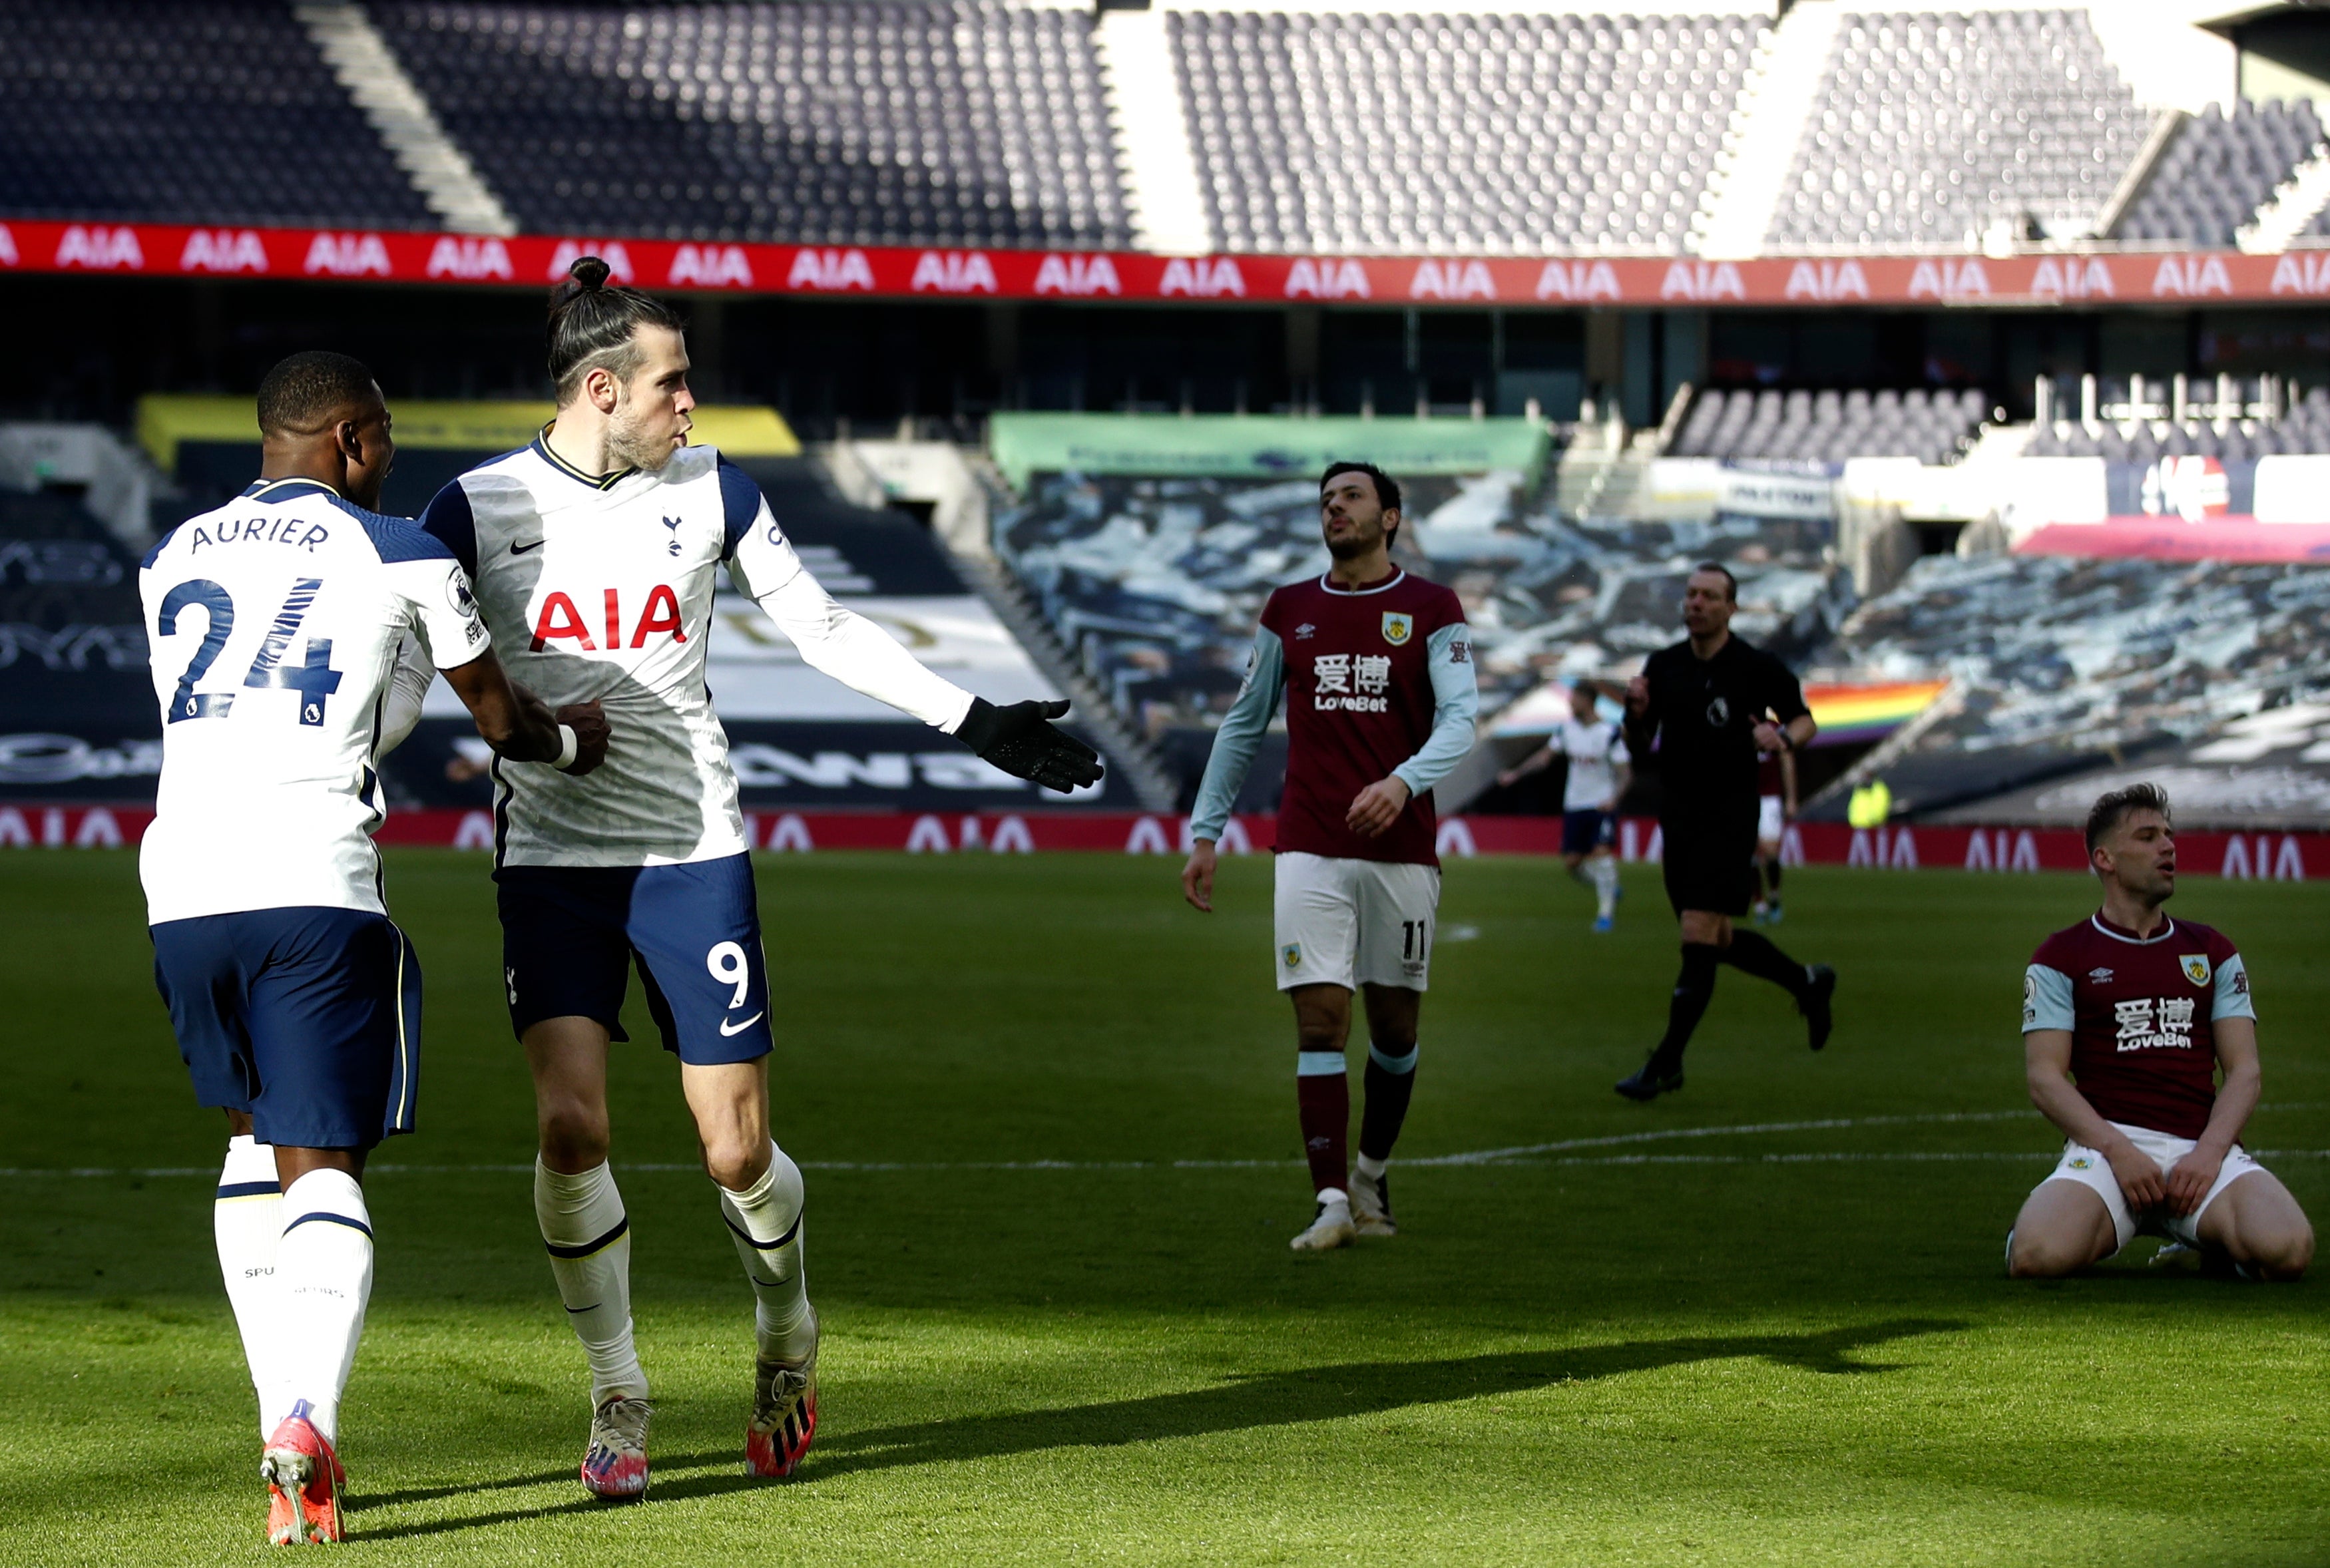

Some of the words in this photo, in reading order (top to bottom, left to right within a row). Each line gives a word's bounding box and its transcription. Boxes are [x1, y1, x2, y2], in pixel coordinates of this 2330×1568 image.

[55, 225, 144, 270] AIA
[180, 228, 269, 274] AIA
[302, 232, 393, 276] AIA
[427, 236, 515, 280] AIA
[668, 244, 754, 288] AIA
[788, 248, 874, 291] AIA
[911, 251, 997, 293] AIA
[1034, 253, 1120, 295] AIA
[1158, 257, 1246, 298] AIA
[1283, 258, 1371, 299] AIA
[1409, 258, 1497, 300] AIA
[1535, 259, 1622, 301] AIA
[1660, 258, 1746, 301] AIA
[1784, 258, 1870, 300] AIA
[1907, 258, 1992, 299] AIA
[2030, 256, 2115, 297] AIA
[2151, 254, 2232, 297] AIA
[192, 518, 329, 555] AURIER
[529, 584, 687, 653] AIA
[159, 577, 344, 727] 24
[1314, 654, 1392, 694] 爱博
[1315, 695, 1388, 713] LoveBet
[742, 813, 816, 853] IA
[907, 814, 1035, 855] AIA
[1847, 827, 1919, 870] AIA
[1965, 829, 2040, 873] AIA
[2221, 833, 2305, 882] AIA
[1402, 920, 1425, 960] 11
[706, 940, 749, 1010] 9
[2115, 997, 2196, 1040] 爱博
